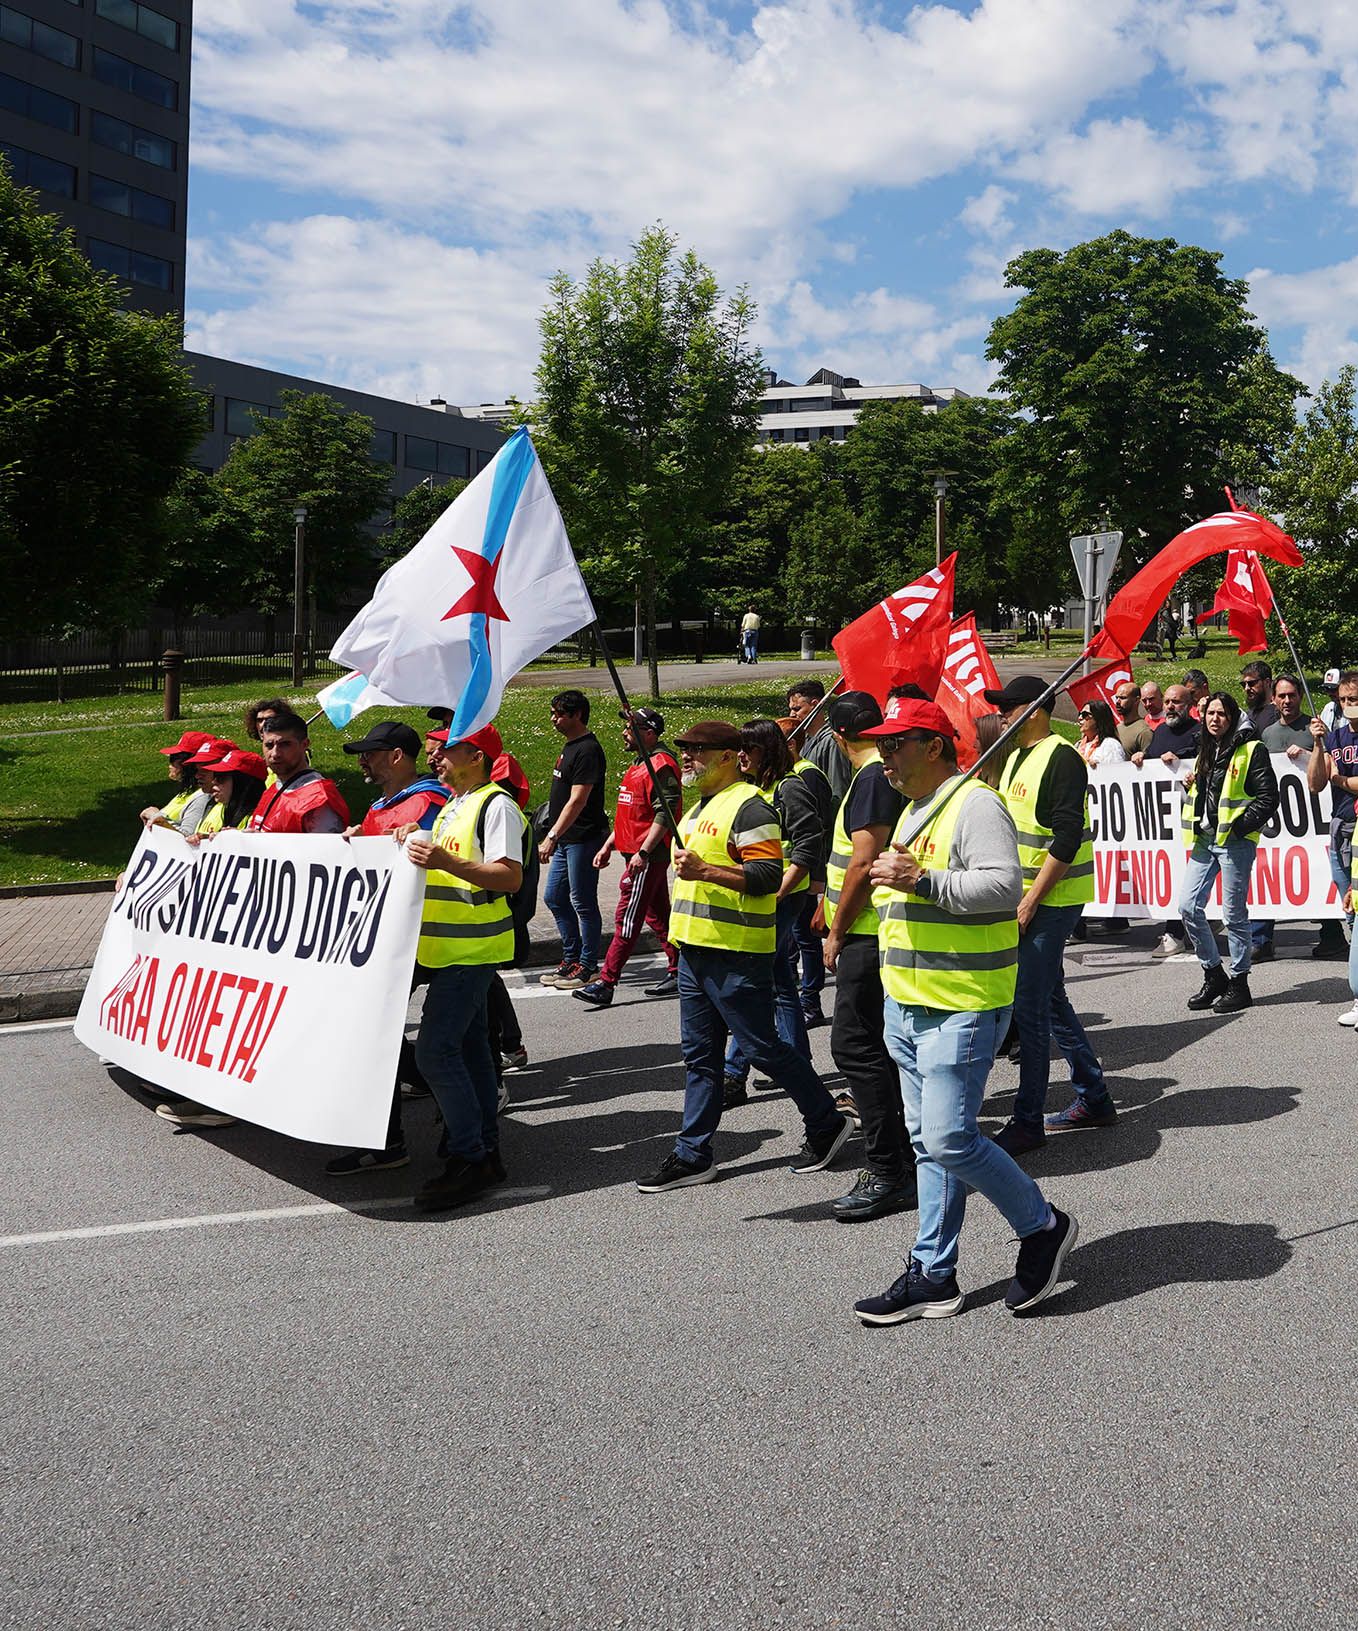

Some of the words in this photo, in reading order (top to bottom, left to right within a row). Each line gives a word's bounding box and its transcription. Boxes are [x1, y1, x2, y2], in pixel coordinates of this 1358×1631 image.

[1087, 782, 1126, 842] CIO
[1096, 849, 1172, 908] VENIO
[157, 962, 188, 1052] O
